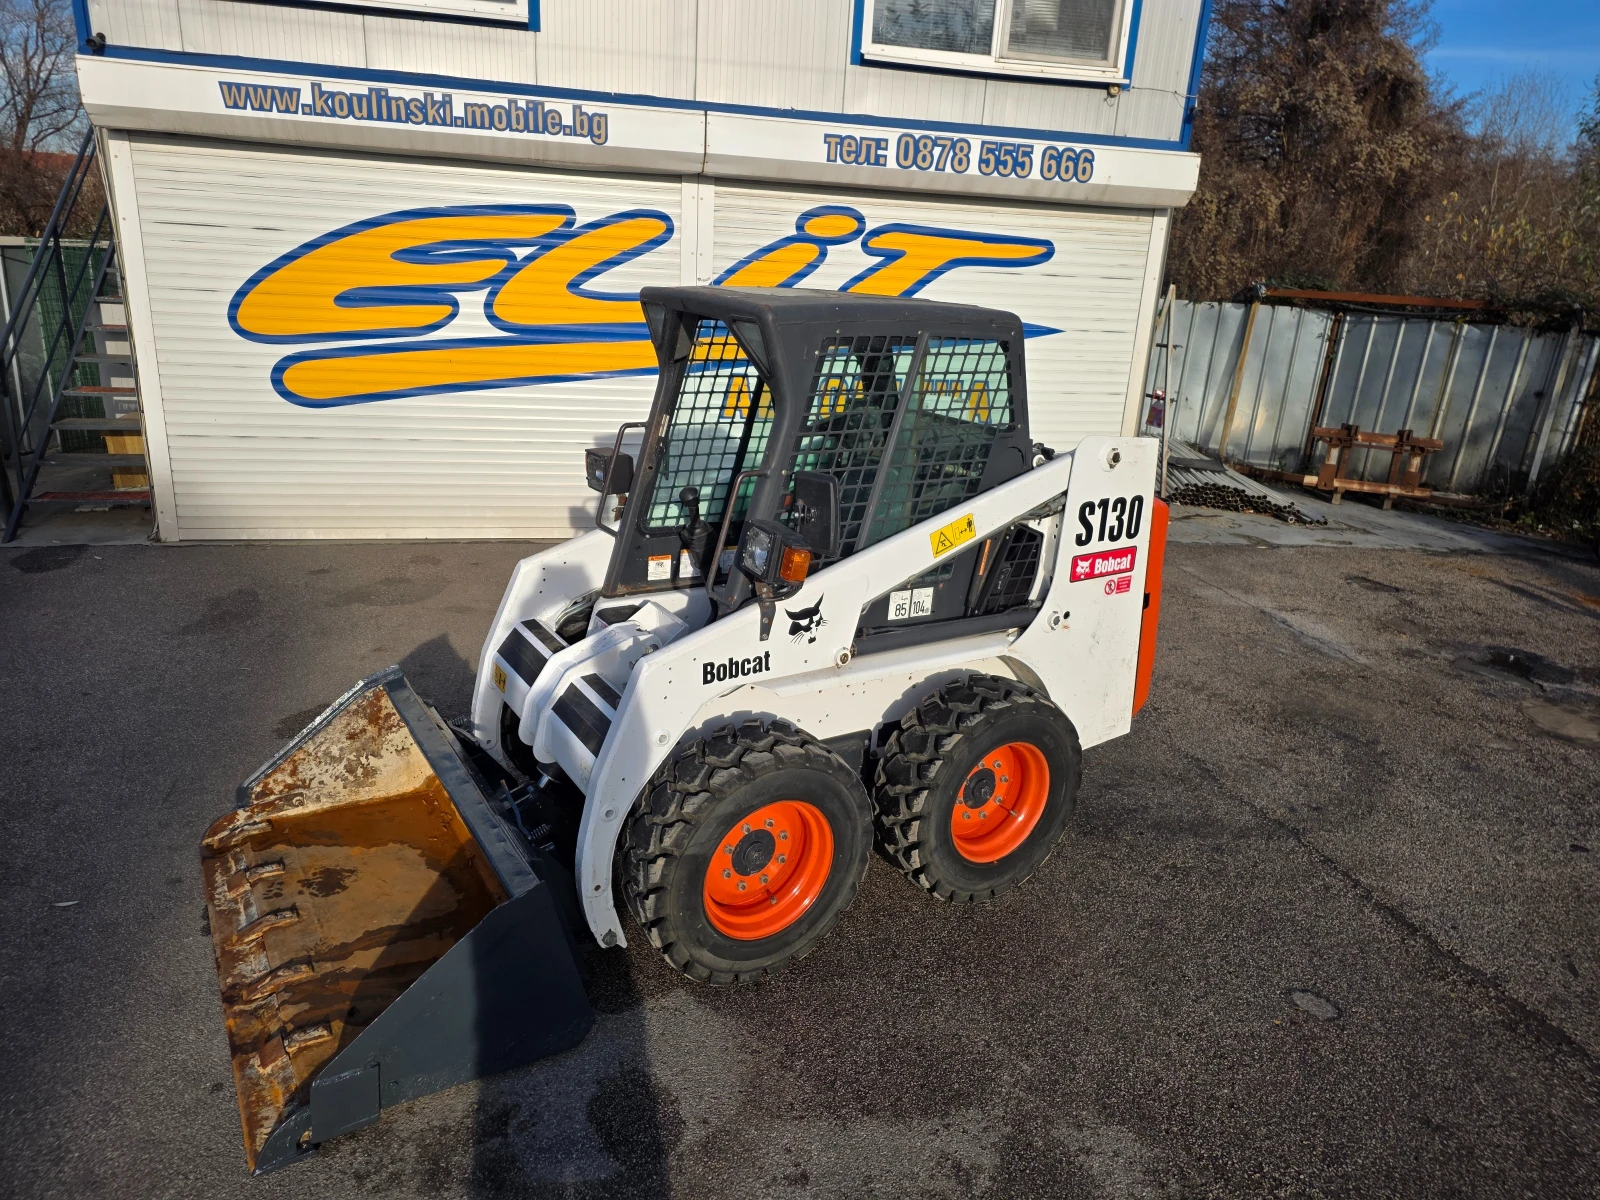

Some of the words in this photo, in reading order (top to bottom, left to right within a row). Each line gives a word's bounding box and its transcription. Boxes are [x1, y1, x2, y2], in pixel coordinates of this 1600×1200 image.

[218, 81, 608, 145] www.koulinski.mobile.bg
[824, 133, 889, 167] тел:
[896, 133, 972, 174] 0878
[978, 140, 1034, 179] 555
[1040, 145, 1095, 183] 666
[1075, 495, 1144, 547] S130
[1094, 554, 1131, 574] Bobcat
[895, 603, 907, 617] 85
[703, 651, 770, 685] Bobcat
